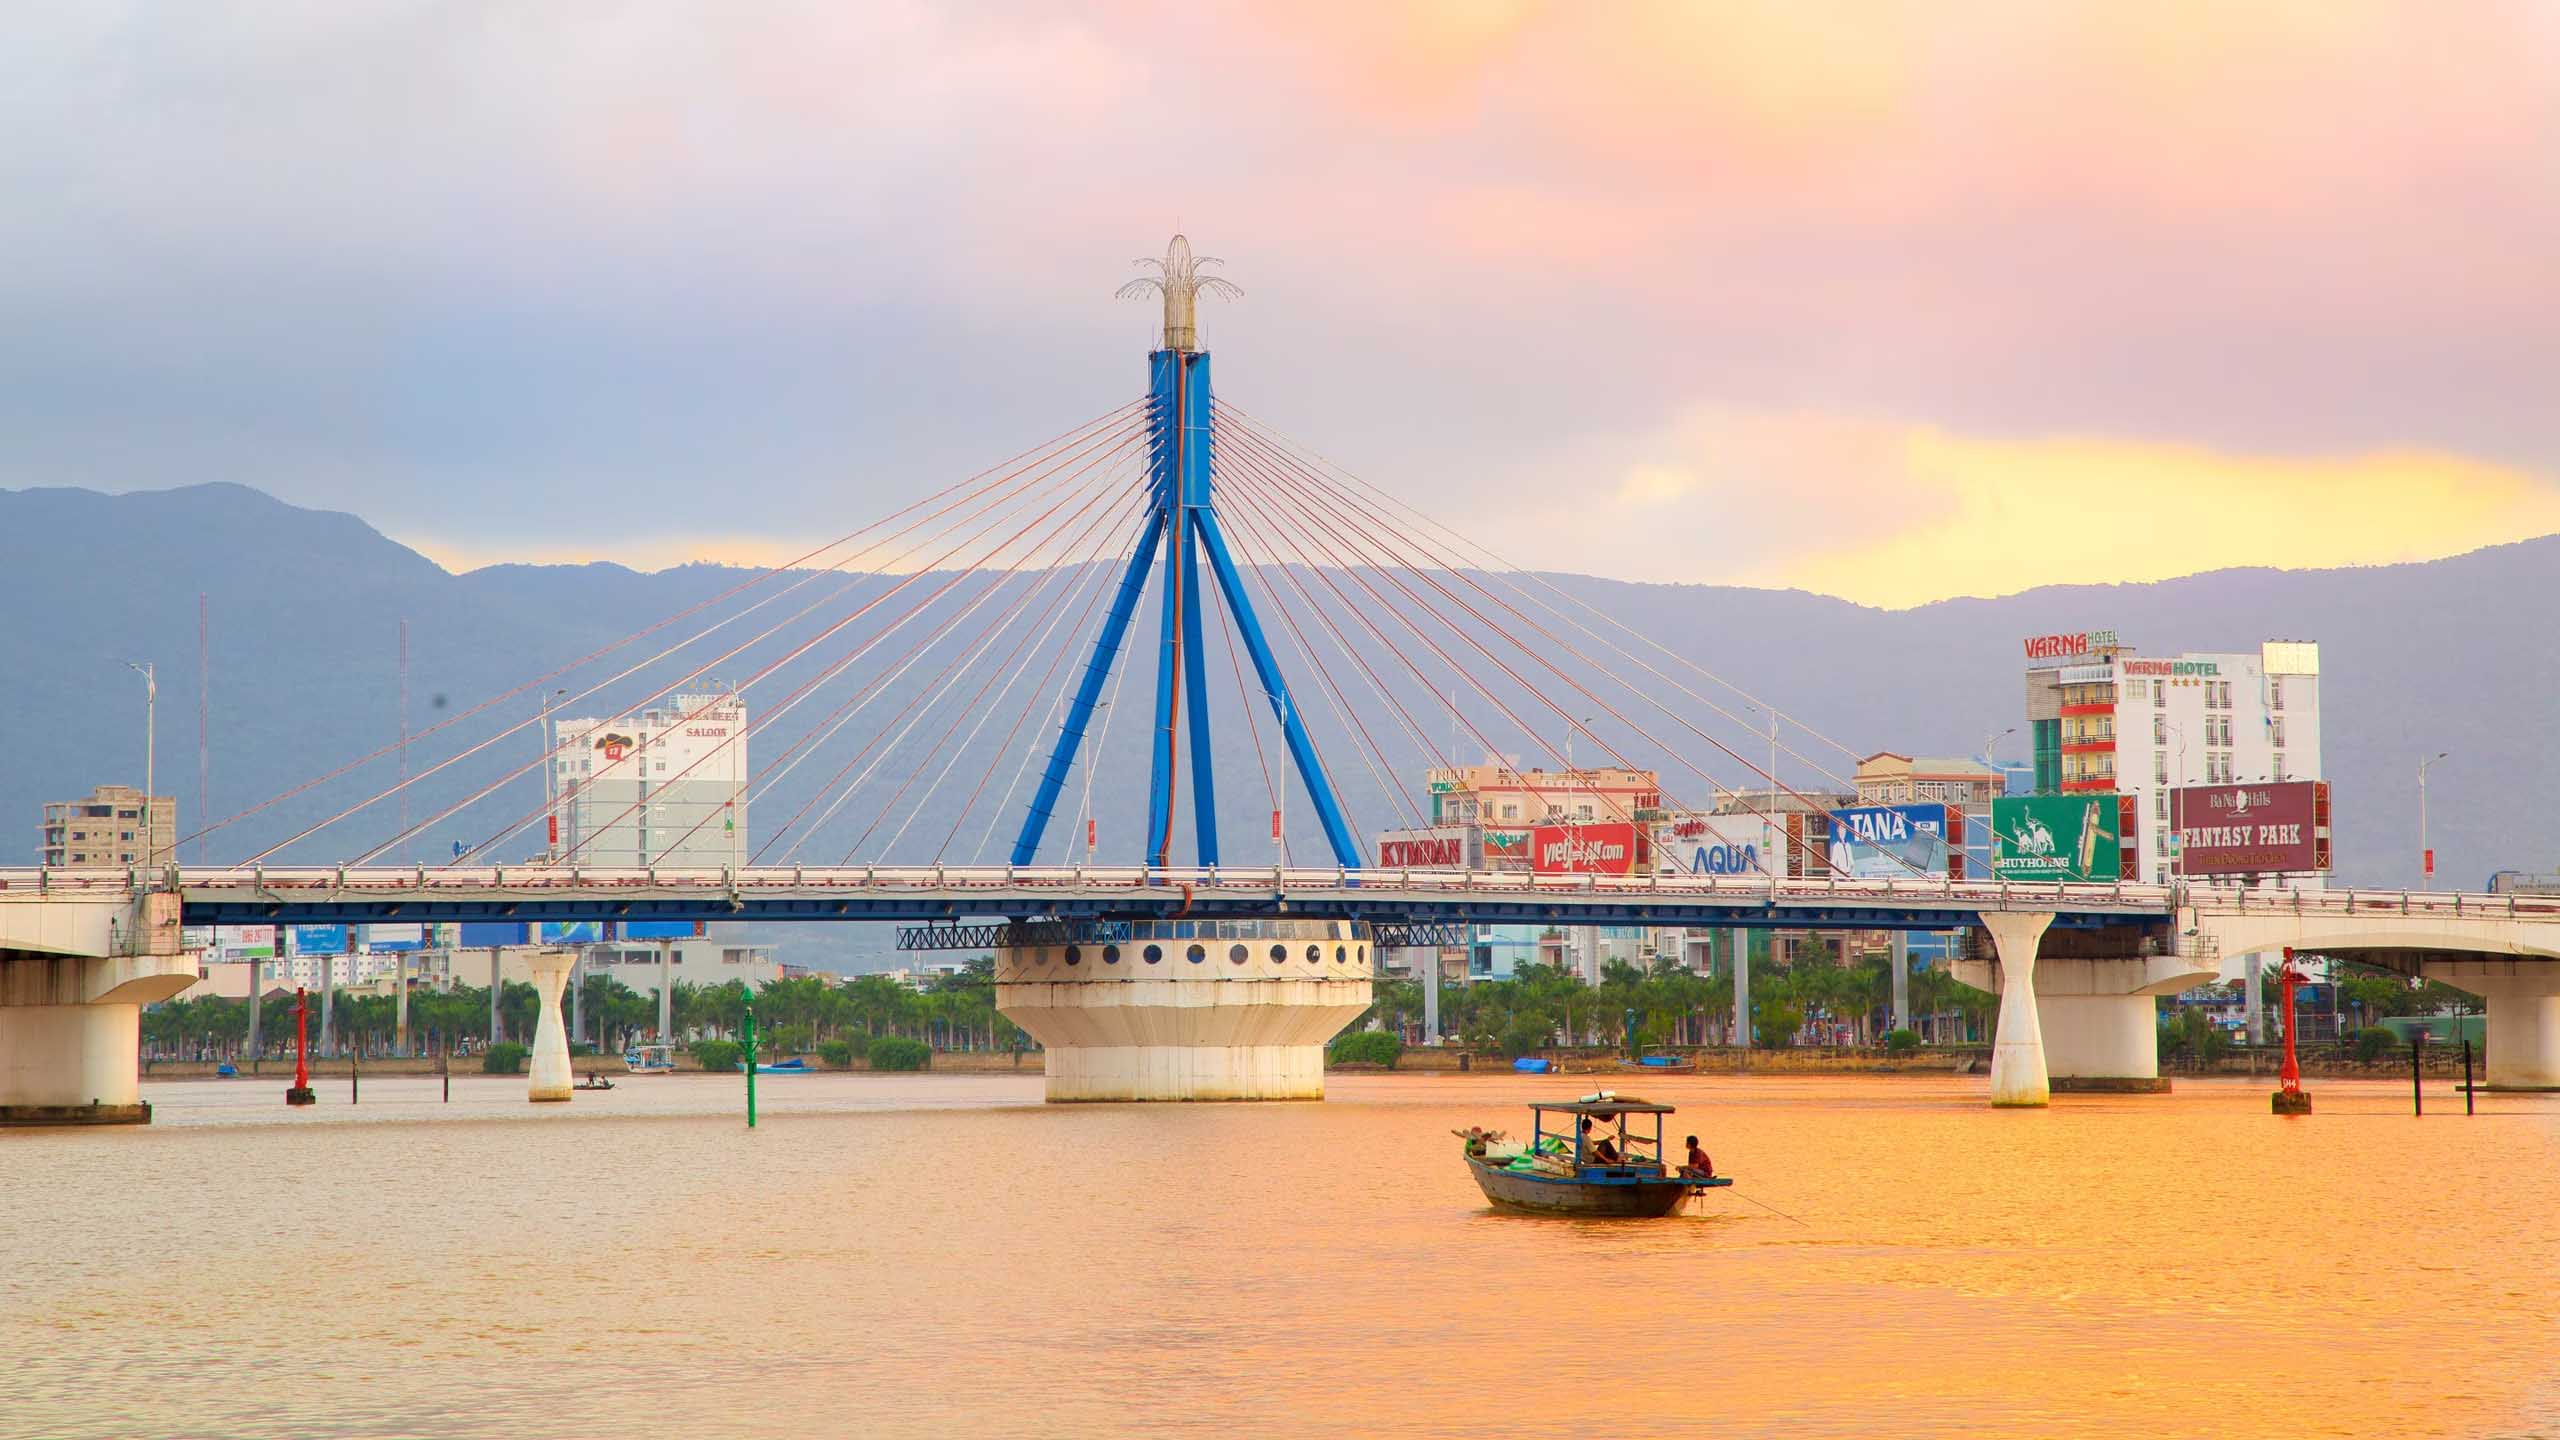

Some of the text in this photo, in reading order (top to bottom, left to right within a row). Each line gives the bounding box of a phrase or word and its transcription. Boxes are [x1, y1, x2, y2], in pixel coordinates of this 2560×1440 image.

[2024, 630, 2118, 657] VARNA HOTEL
[2123, 661, 2221, 676] VARNA HOTEL
[686, 728, 727, 737] SALOON
[2248, 791, 2271, 807] Hills
[2183, 823, 2301, 848] FANTASY PARK
[1380, 838, 1462, 867] KYMDAN
[1693, 844, 1759, 875] AQUA
